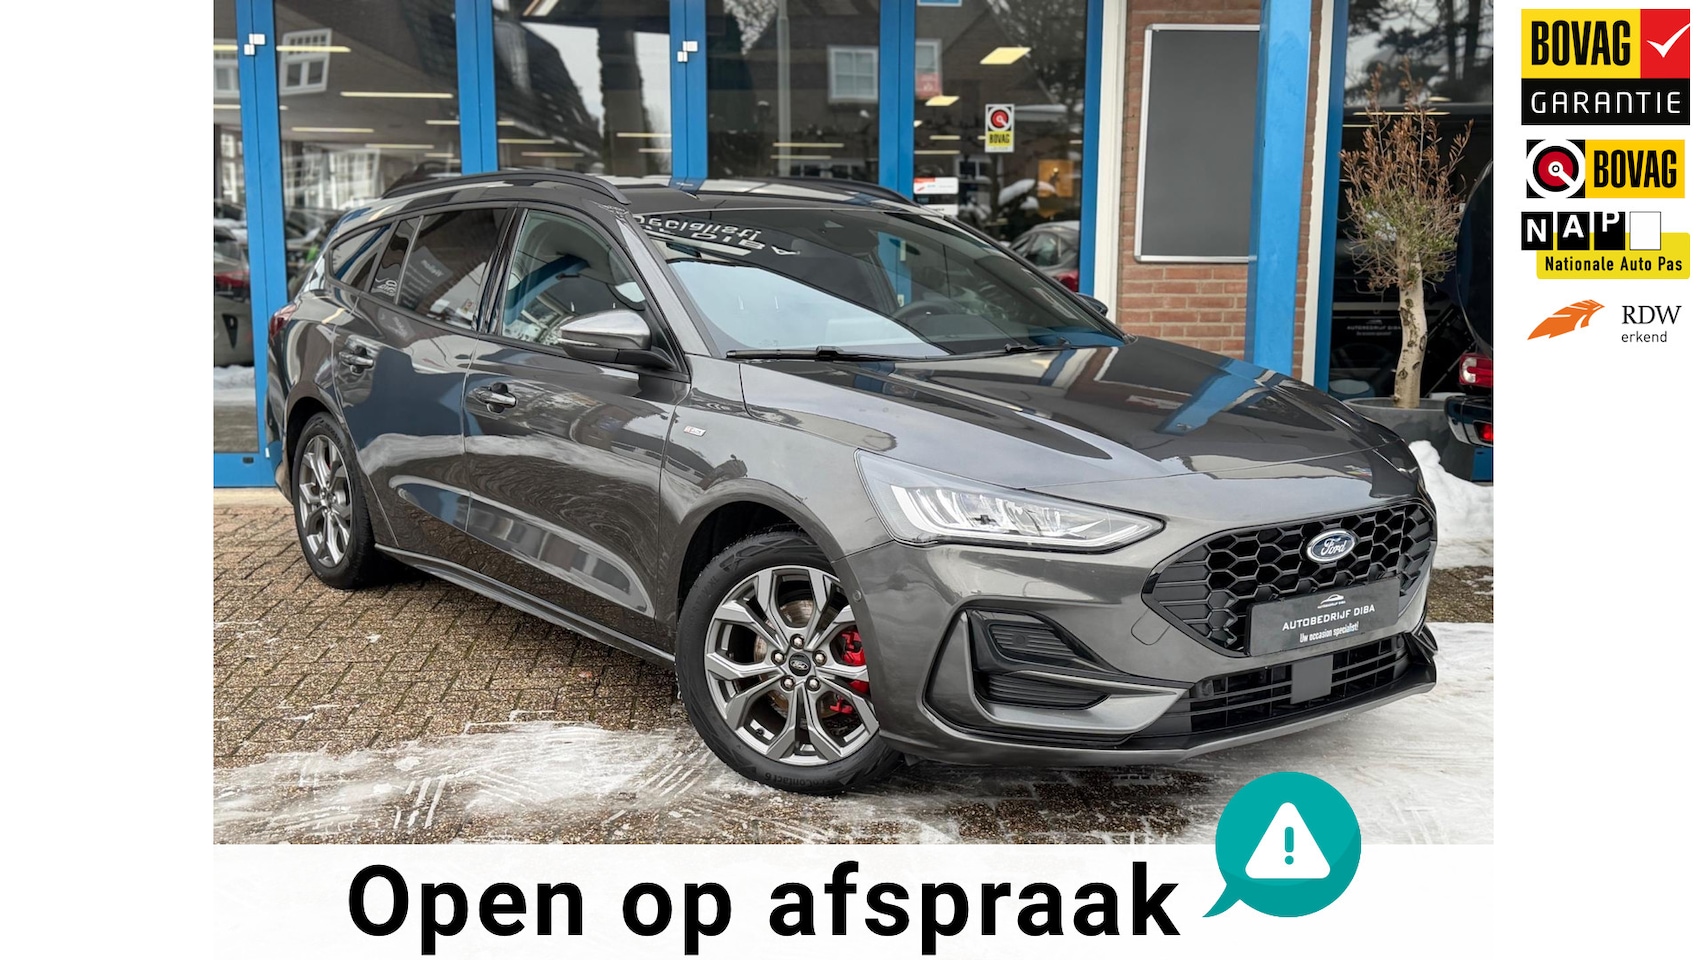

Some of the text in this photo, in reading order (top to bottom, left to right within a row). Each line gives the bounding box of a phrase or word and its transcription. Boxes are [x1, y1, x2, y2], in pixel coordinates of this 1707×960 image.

[1320, 537, 1348, 556] Ford
[1282, 609, 1352, 631] AUTOBEDRIJF
[1353, 604, 1375, 616] DIBA
[1309, 628, 1333, 641] occasion
